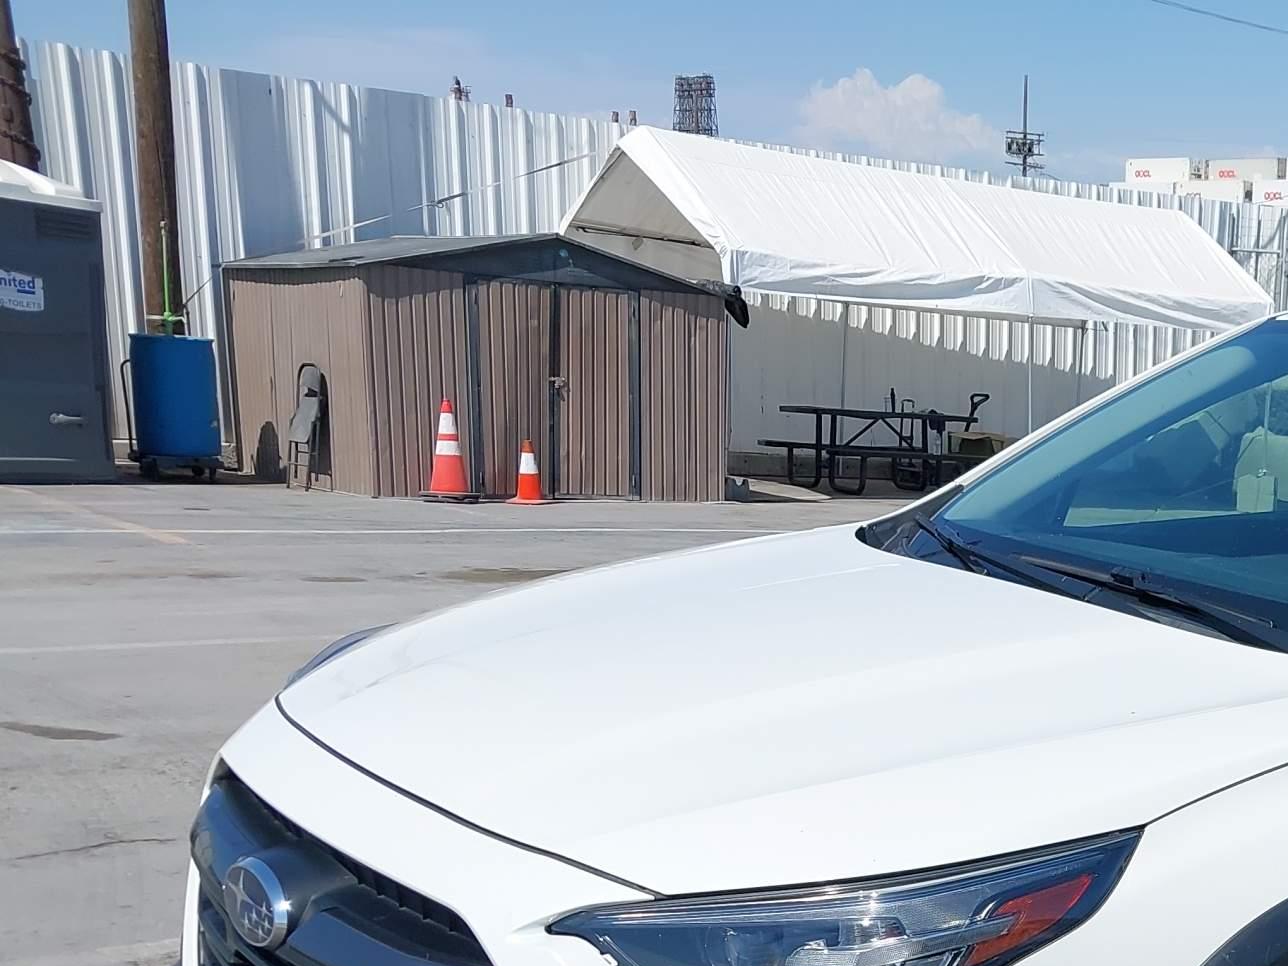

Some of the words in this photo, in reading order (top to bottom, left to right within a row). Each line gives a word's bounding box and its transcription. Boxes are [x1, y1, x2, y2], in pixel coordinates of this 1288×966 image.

[1135, 169, 1151, 178] OOCL
[1218, 170, 1236, 178] OOCL
[1264, 191, 1283, 200] OOCL
